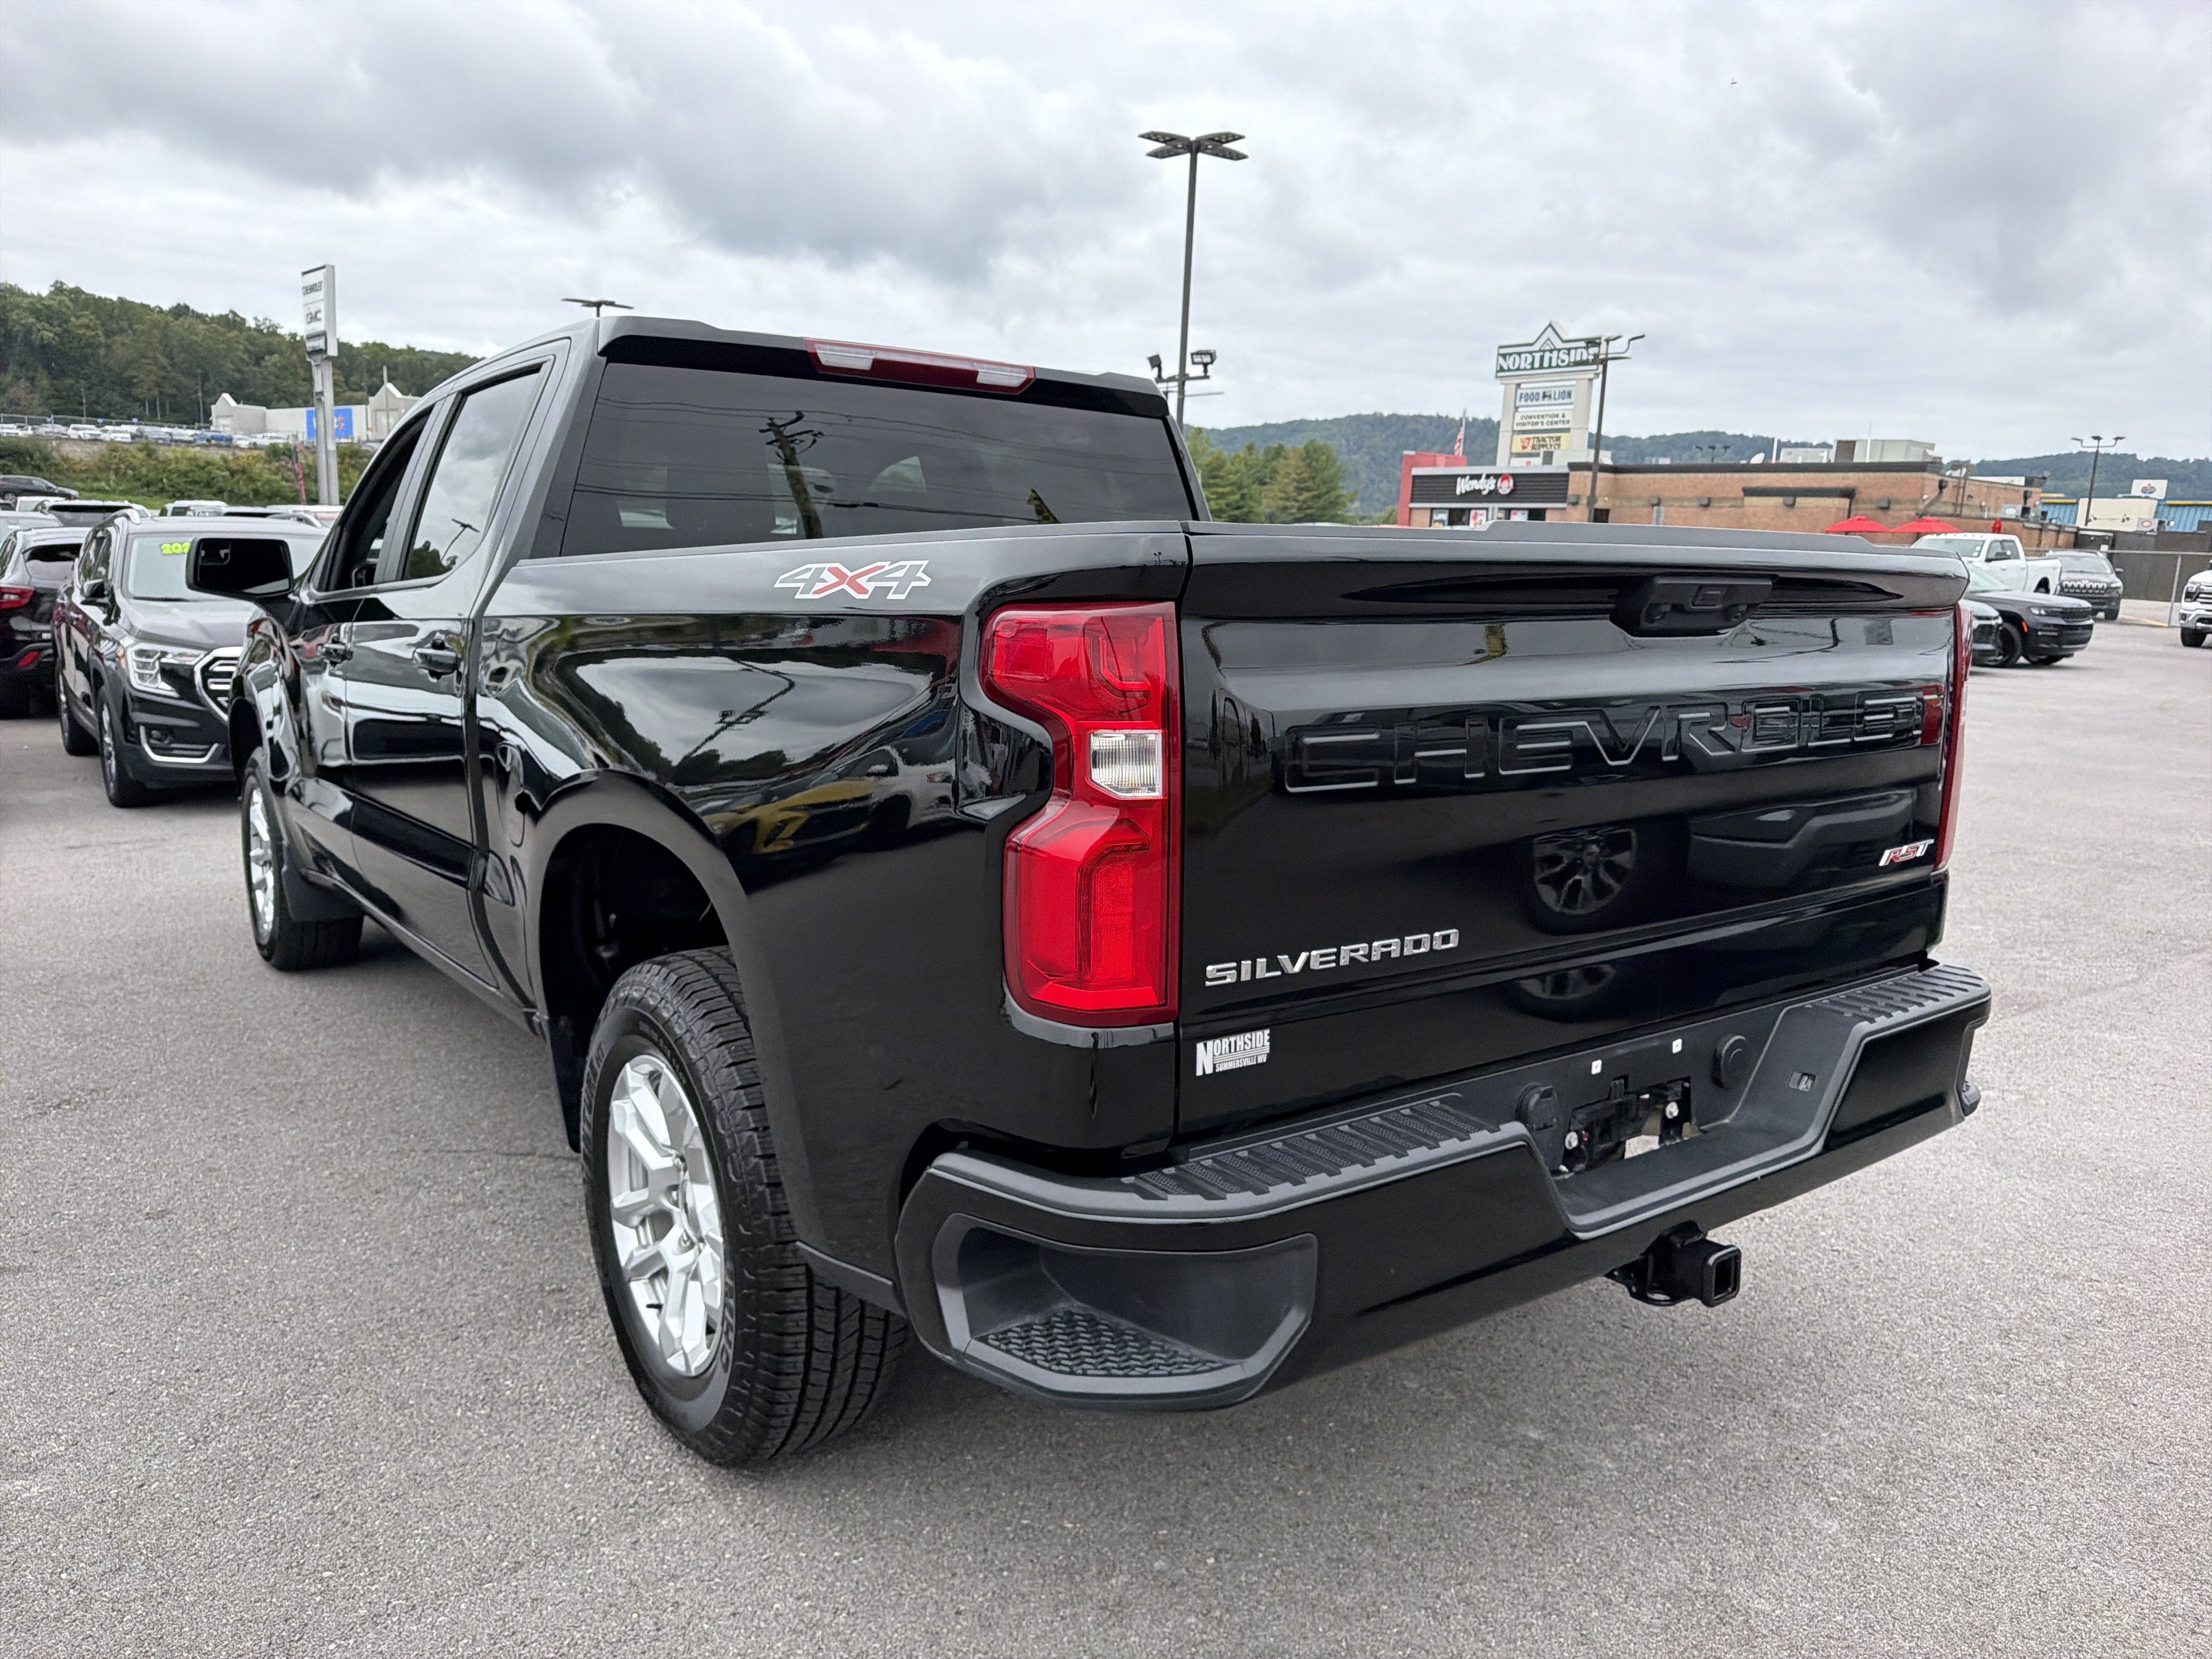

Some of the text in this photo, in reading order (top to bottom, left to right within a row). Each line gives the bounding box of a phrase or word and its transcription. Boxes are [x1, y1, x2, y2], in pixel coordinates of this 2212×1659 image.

[1519, 390, 1572, 403] FOOD LION
[1456, 472, 1497, 495] Wendy's
[1285, 685, 1943, 793] CHEVROLET
[1878, 839, 1934, 866] RST
[1205, 929, 1459, 986] SILVERADO
[1196, 1029, 1270, 1076] NORTHSIDE
[1215, 1053, 1267, 1073] SUMMERSVILLE WV
